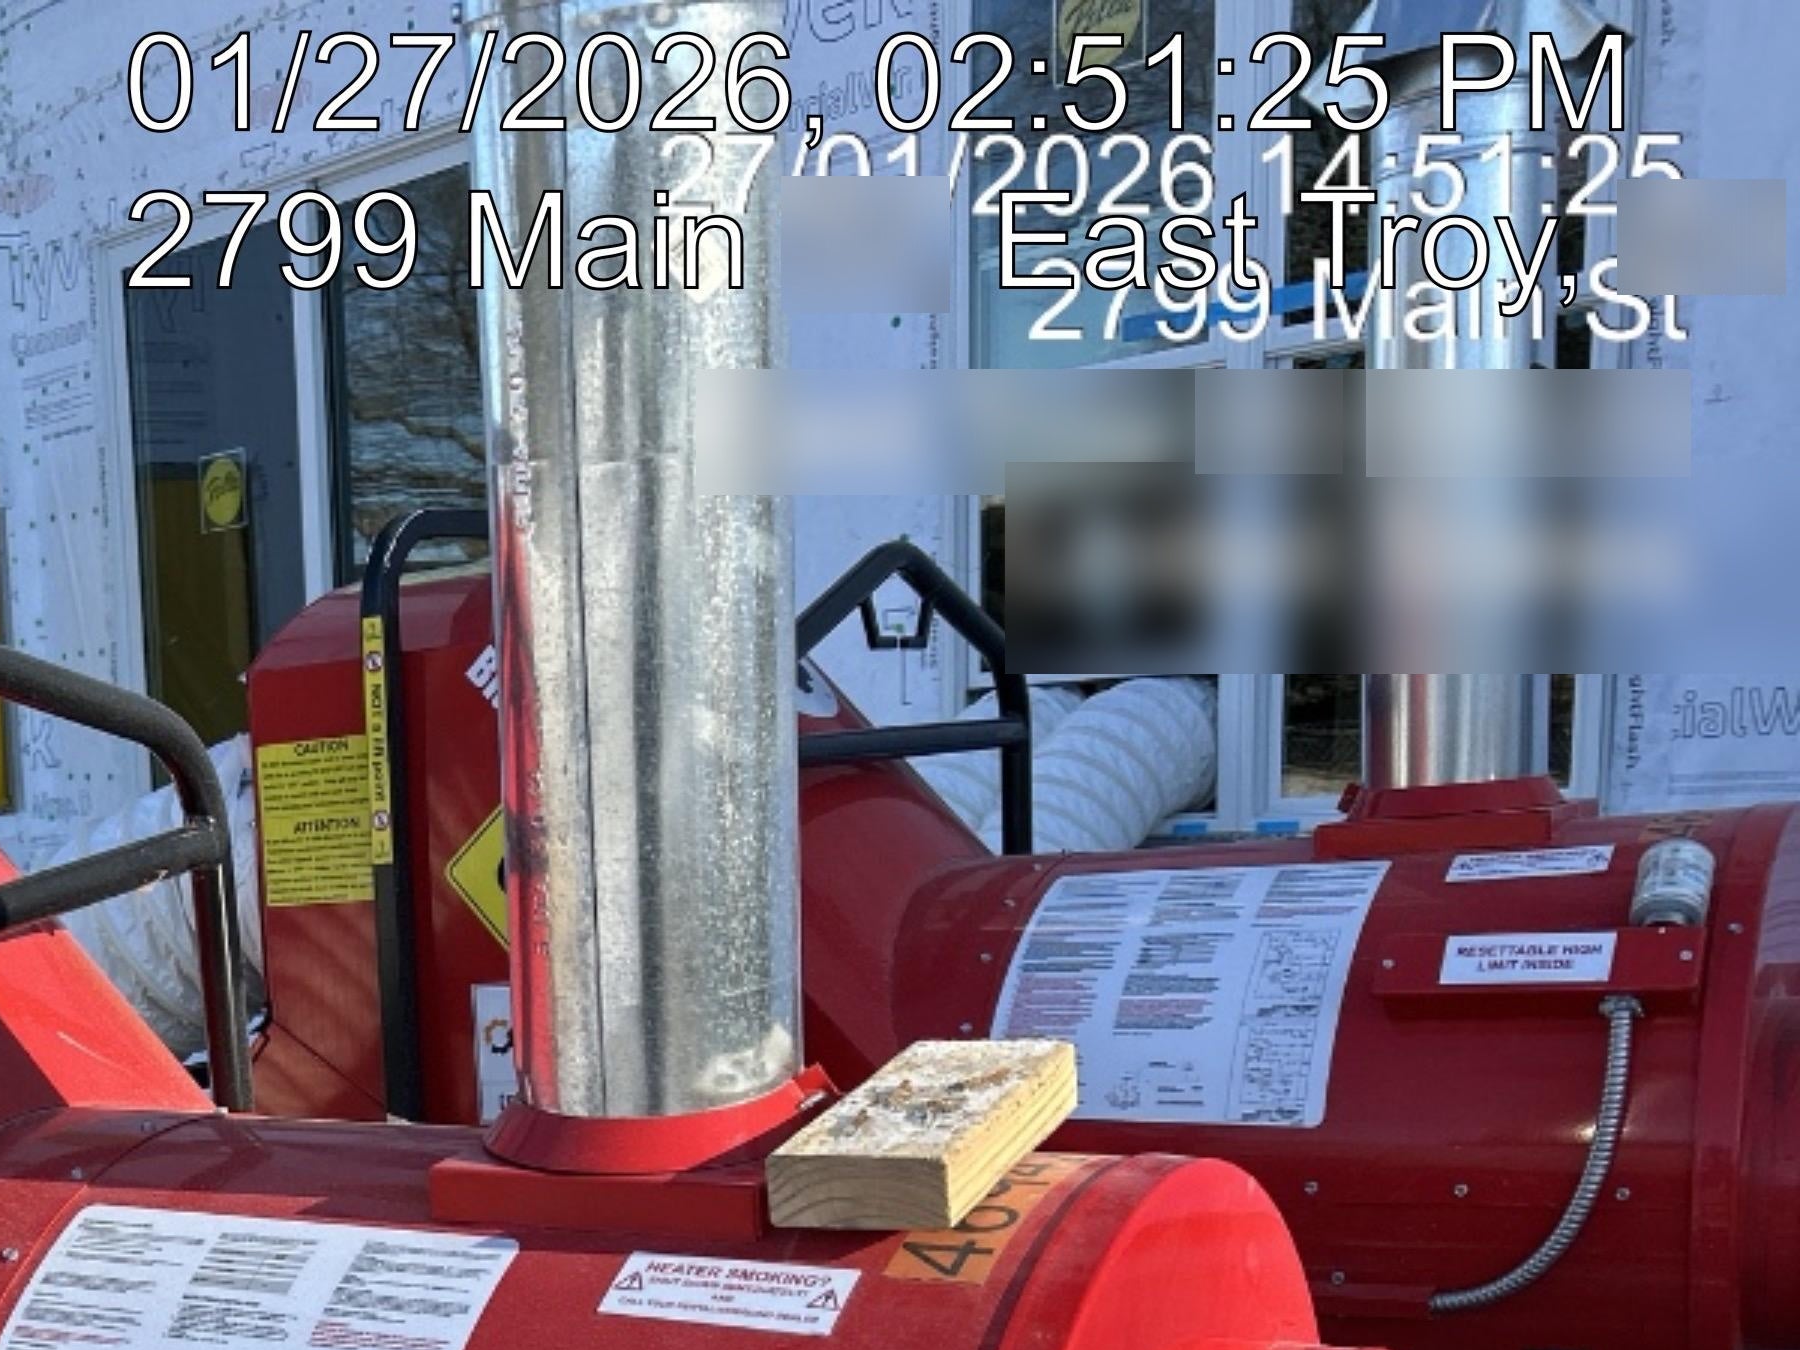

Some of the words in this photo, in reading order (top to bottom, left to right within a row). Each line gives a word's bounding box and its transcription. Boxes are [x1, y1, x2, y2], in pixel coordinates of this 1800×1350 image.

[293, 740, 350, 757] CAUTION
[293, 816, 361, 836] ATTENTION
[646, 1261, 722, 1279] HEATER
